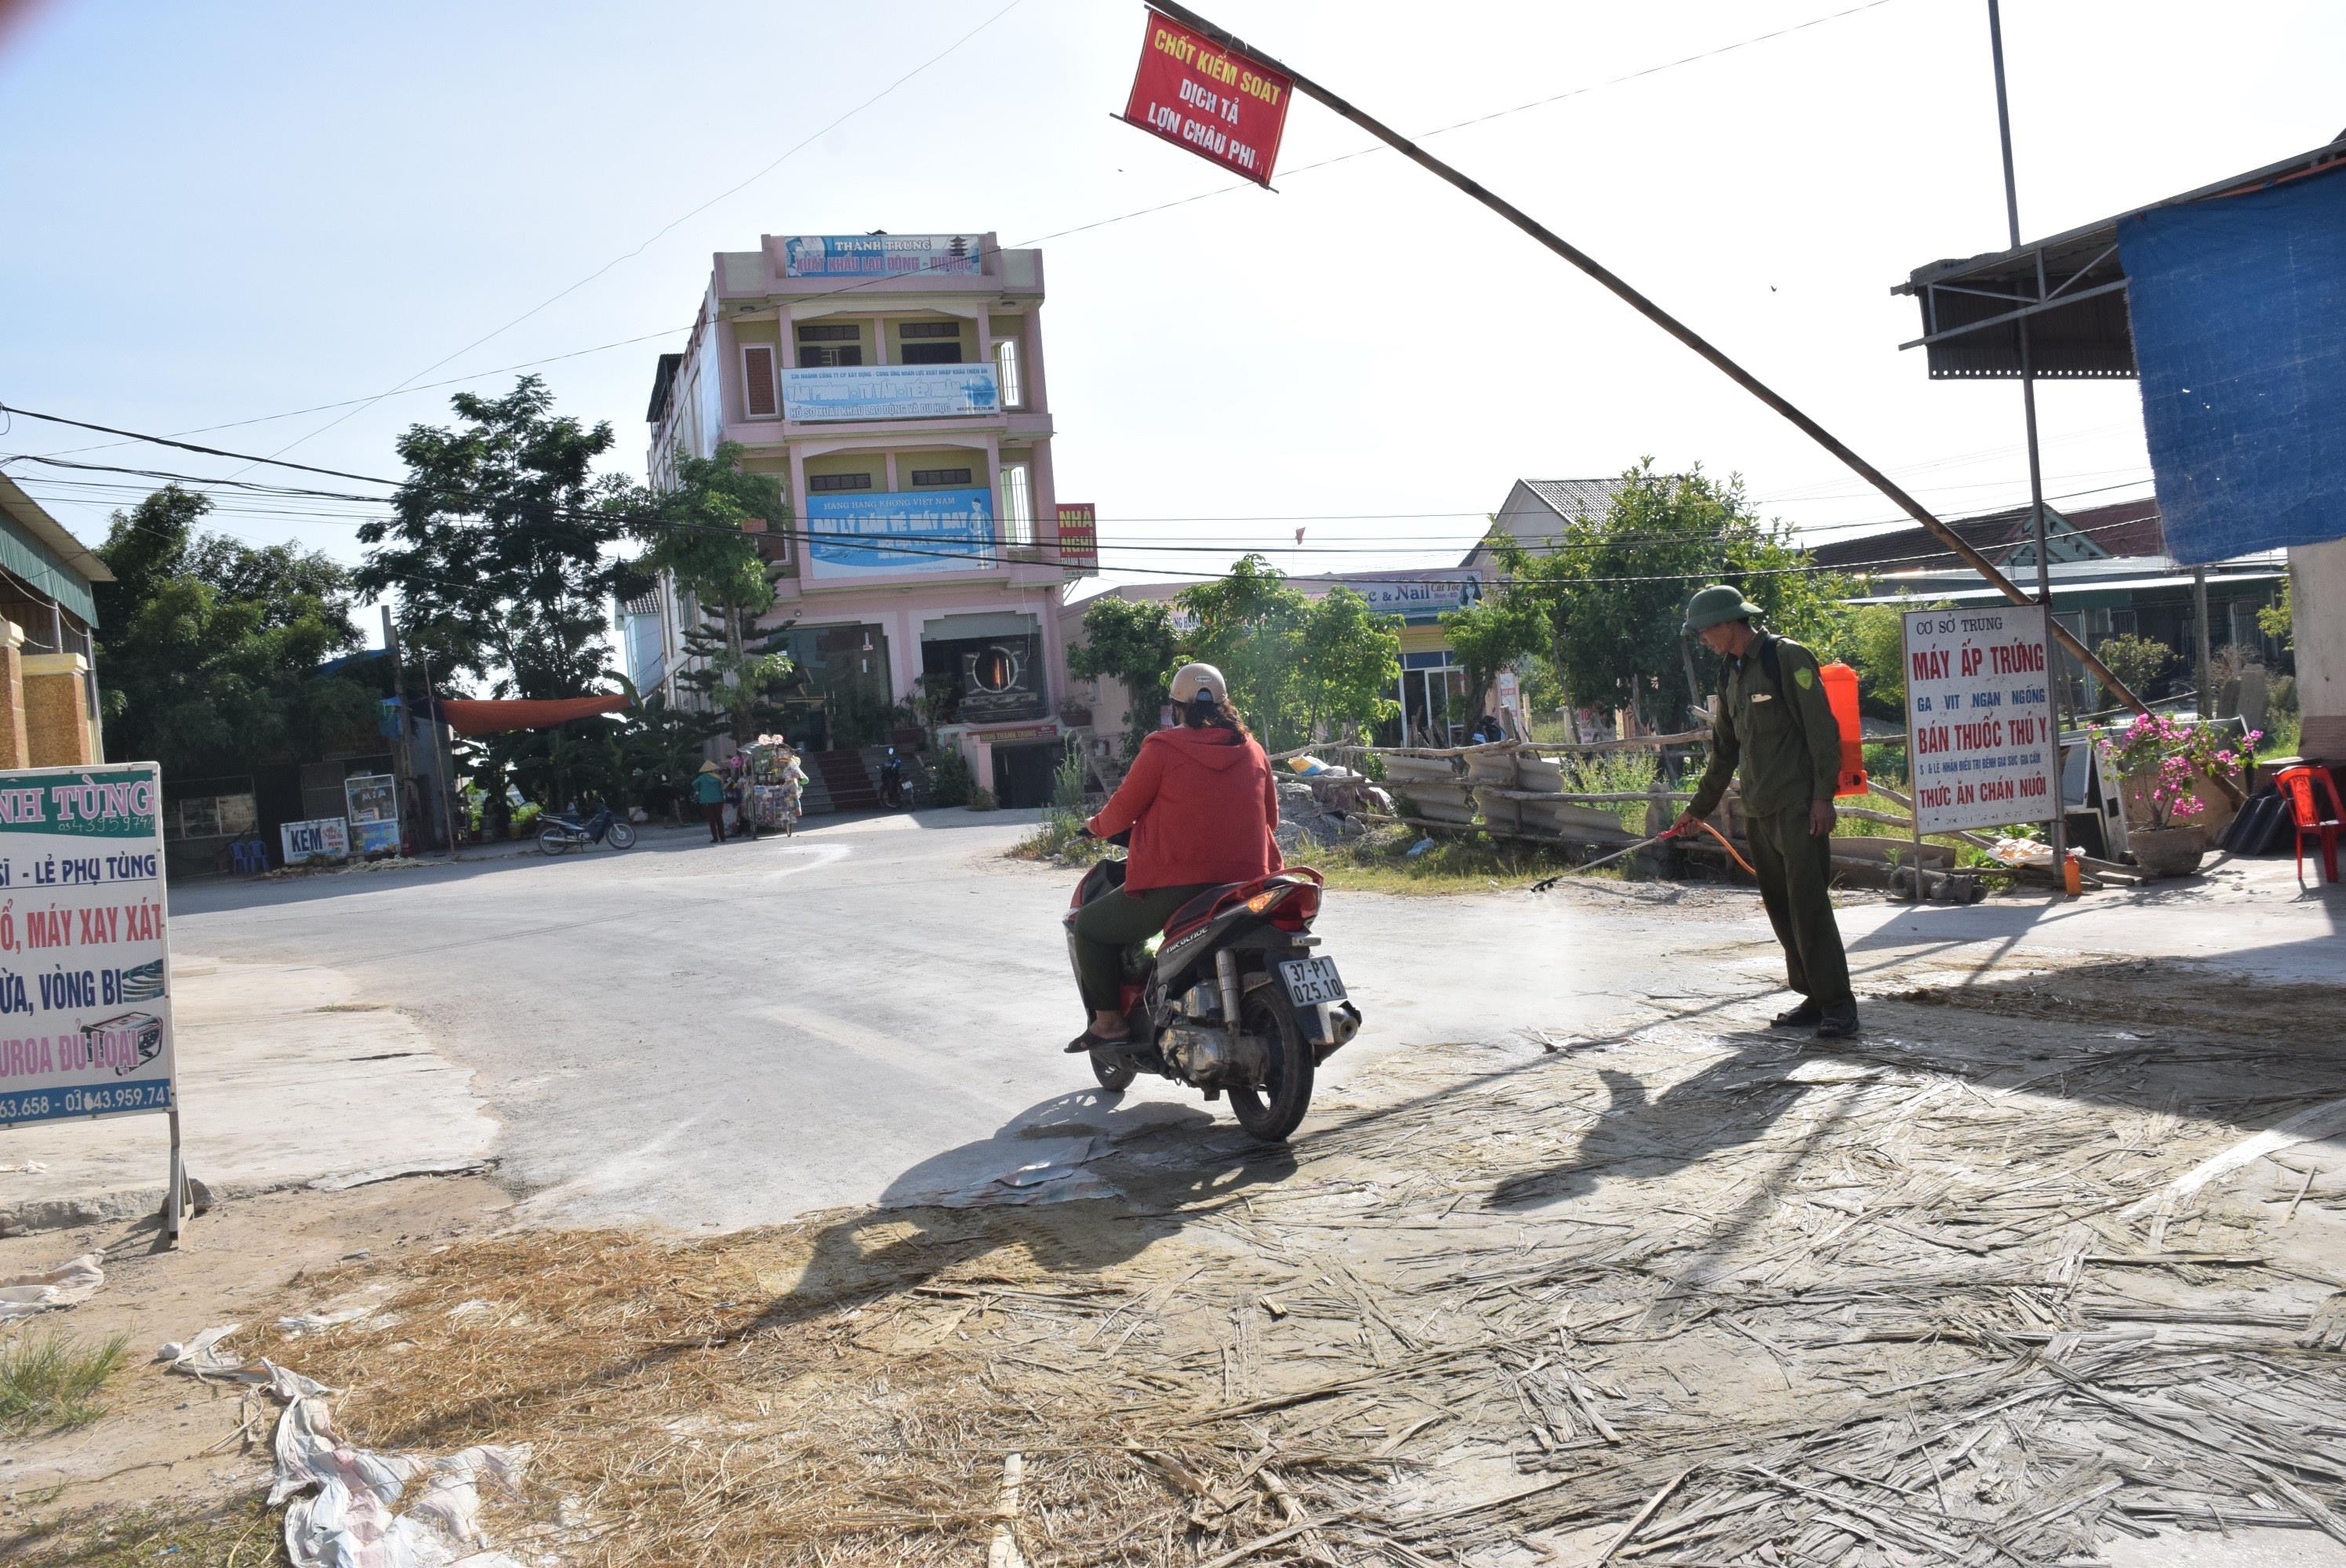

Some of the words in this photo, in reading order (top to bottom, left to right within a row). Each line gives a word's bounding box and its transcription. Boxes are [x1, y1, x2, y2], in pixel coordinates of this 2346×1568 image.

[1154, 28, 1197, 64] CHỐT
[1197, 53, 1238, 87] KIỂM
[1240, 71, 1281, 106] SOÁT
[1179, 78, 1216, 113] DỊCH
[1221, 97, 1240, 125] TẢ
[1148, 102, 1182, 134] LỢN
[1182, 119, 1226, 154] CHÂU
[1228, 140, 1255, 169] PHI
[834, 238, 881, 251] THÀNH
[885, 240, 931, 251] TRUNG
[935, 497, 955, 506] NAM
[1059, 506, 1093, 528] NHÀ
[1061, 529, 1094, 553] NGHỈ
[1079, 556, 1097, 568] TRUNG
[1382, 591, 1392, 601] &
[1395, 584, 1430, 601] Nail
[1916, 620, 1932, 635] CƠ
[1939, 612, 1955, 633] SỞ
[1961, 617, 2003, 633] TRUNG
[1912, 643, 1949, 681] MÁY
[1962, 638, 1983, 677] ẤP
[1990, 637, 2044, 675] TRỨNG
[1972, 691, 2001, 708] NGAN
[1918, 720, 1949, 754] BÁN
[1954, 712, 2002, 751] THUỐC
[2008, 711, 2034, 746] THÚ
[2039, 717, 2046, 743] Y
[52, 775, 154, 821] TÙNG
[1919, 780, 1951, 808] THỨC
[1957, 778, 1974, 804] ĂN
[2020, 771, 2046, 797] NUÔI
[291, 827, 322, 852] KEM
[35, 854, 56, 884] LẺ
[62, 858, 100, 885] PHỤ
[106, 851, 157, 879] TÙNG
[27, 903, 71, 949] MÁY
[79, 906, 118, 946] XAY
[125, 897, 162, 941] XÁT
[1290, 960, 1329, 982] 37-P1
[39, 964, 96, 1010] VÒNG
[101, 969, 122, 1005] BI
[1293, 978, 1342, 1003] 025.10
[59, 1018, 86, 1072] ĐỦ
[92, 1029, 138, 1075] LOẠI
